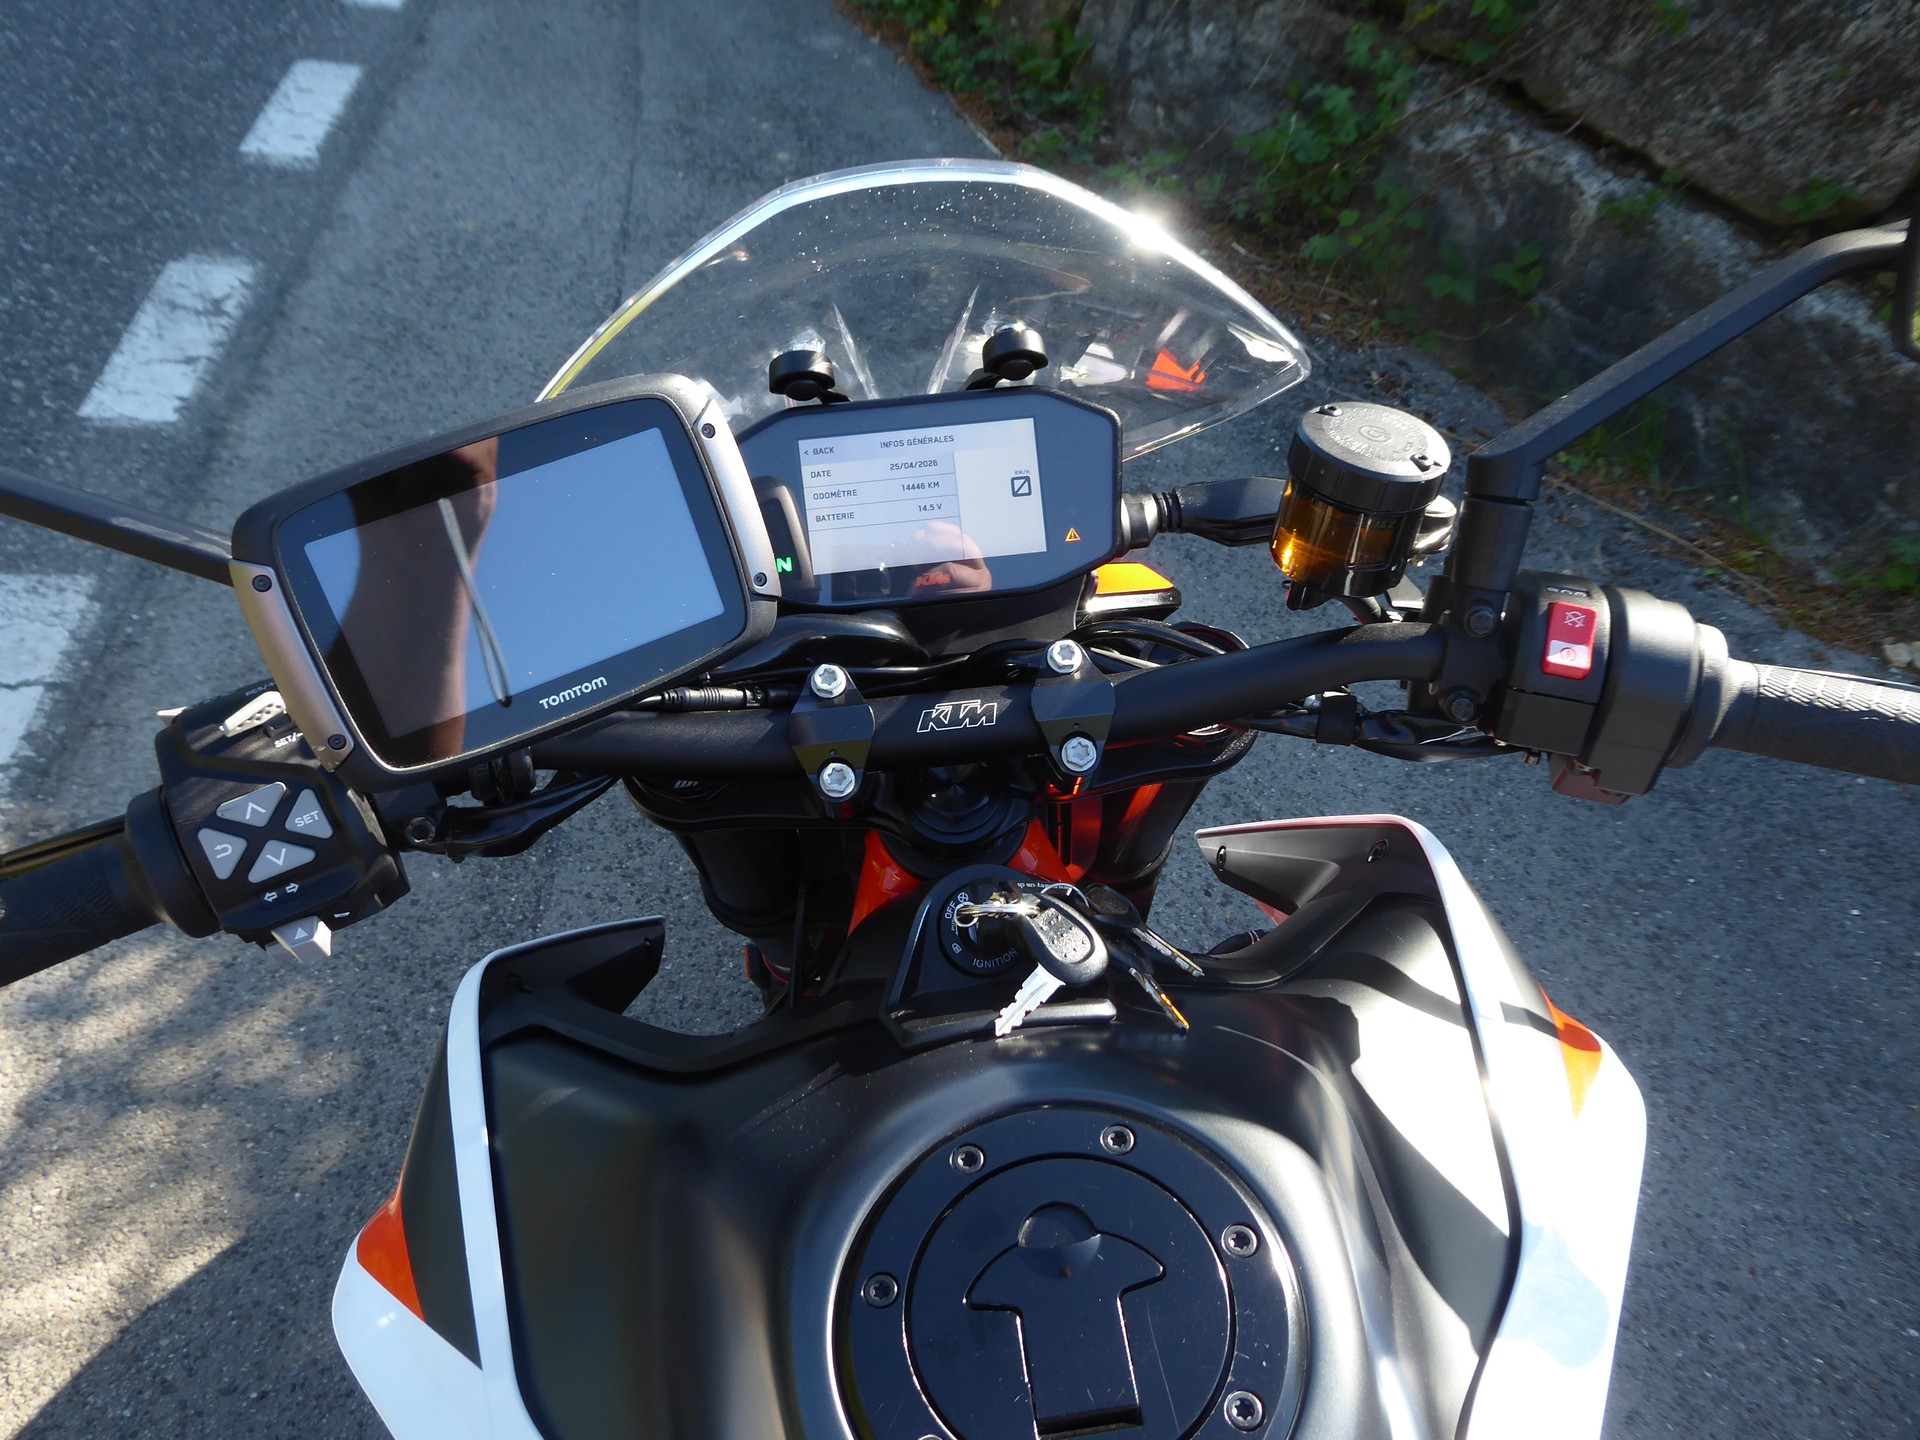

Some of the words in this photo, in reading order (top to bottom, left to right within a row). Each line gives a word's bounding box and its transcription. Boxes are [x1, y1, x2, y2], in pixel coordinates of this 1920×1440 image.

[880, 440, 905, 449] INFOS
[907, 434, 955, 446] GÉNÉRALES
[812, 446, 835, 456] BACK
[890, 459, 938, 471] 25/04/2026
[810, 470, 832, 478] DATE
[901, 482, 926, 491] 14446
[927, 481, 940, 489] KM
[813, 489, 858, 500] ODOMÈTRE
[918, 503, 935, 512] 14.5
[815, 511, 855, 522] BATTERIE
[776, 556, 792, 573] N
[915, 571, 951, 587] KTM
[916, 699, 998, 733] KTM
[294, 810, 319, 827] SET
[944, 900, 957, 919] OFF
[972, 947, 1018, 969] IGNITION
